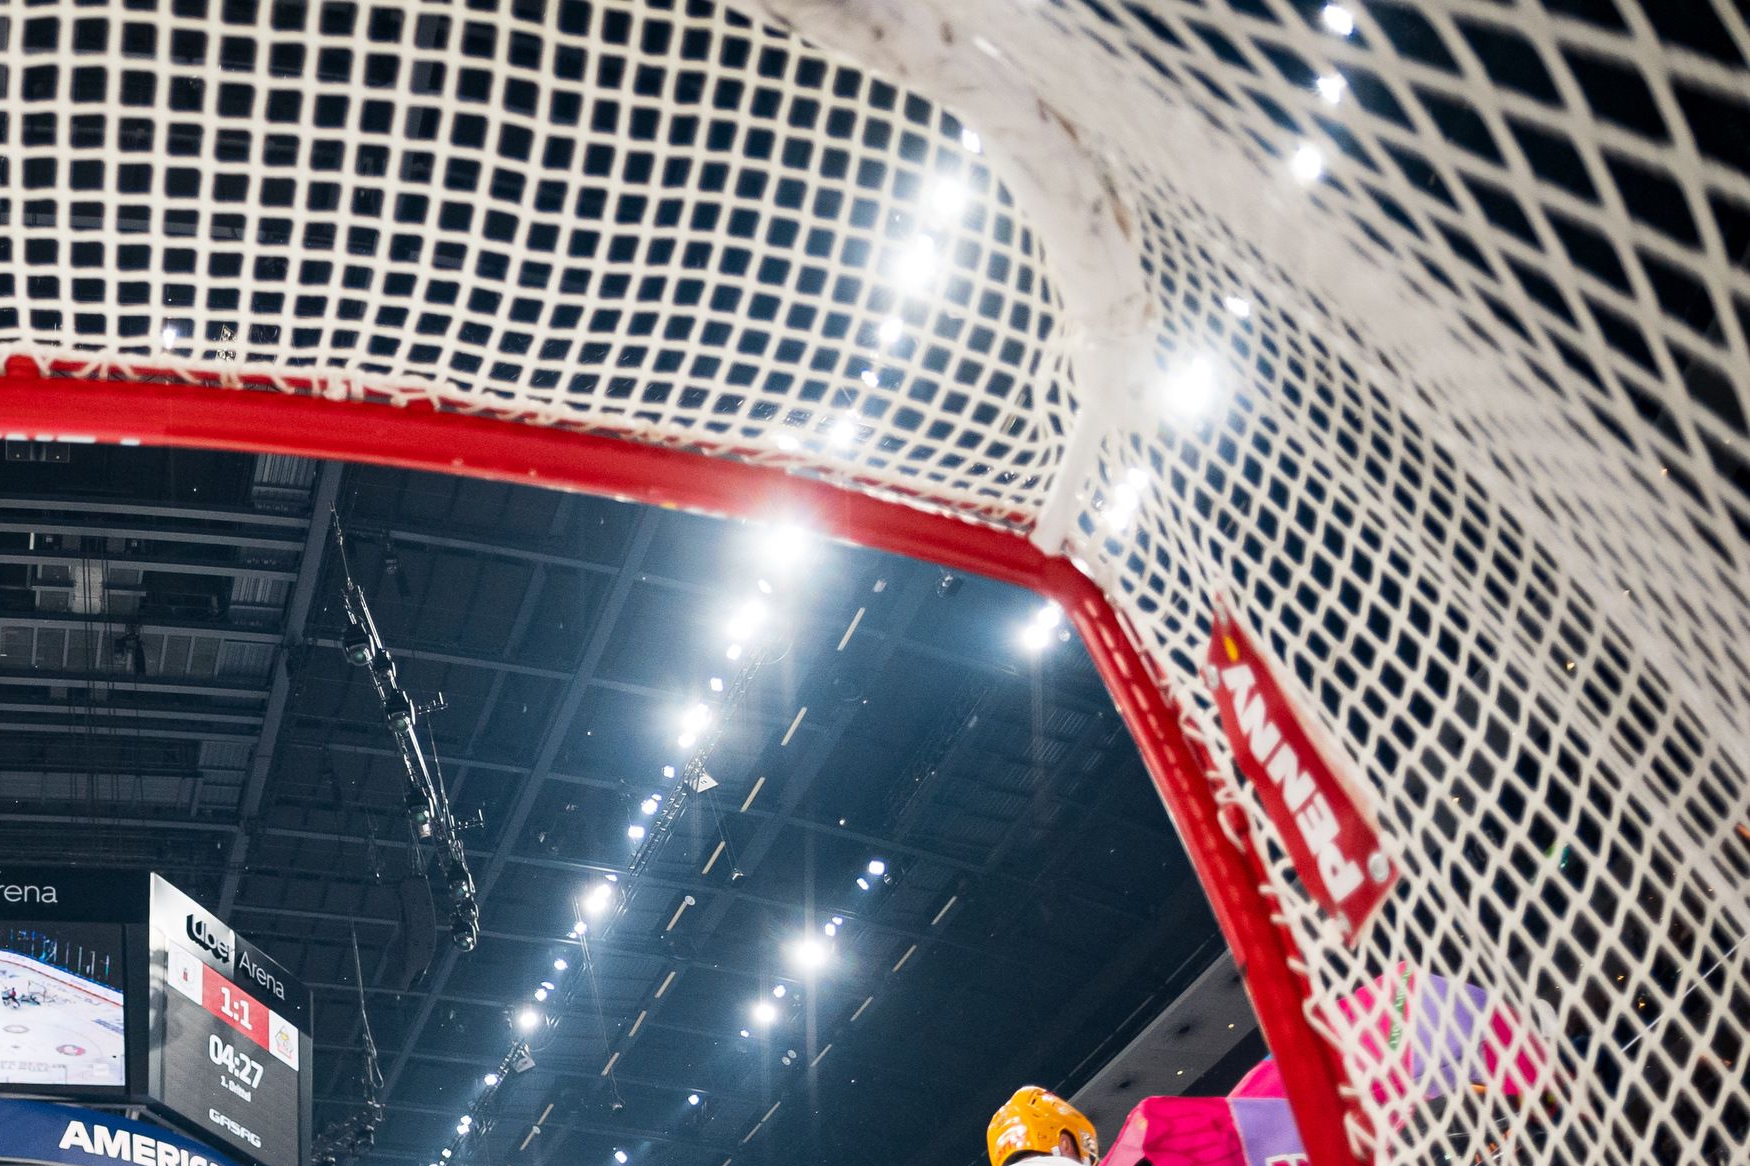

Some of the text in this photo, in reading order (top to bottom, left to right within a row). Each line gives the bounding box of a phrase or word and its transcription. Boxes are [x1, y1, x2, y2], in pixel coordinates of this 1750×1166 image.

[238, 953, 285, 1000] Arena
[220, 986, 253, 1031] 1:1
[208, 1034, 264, 1089] 04:27
[208, 1107, 262, 1149] GASAG
